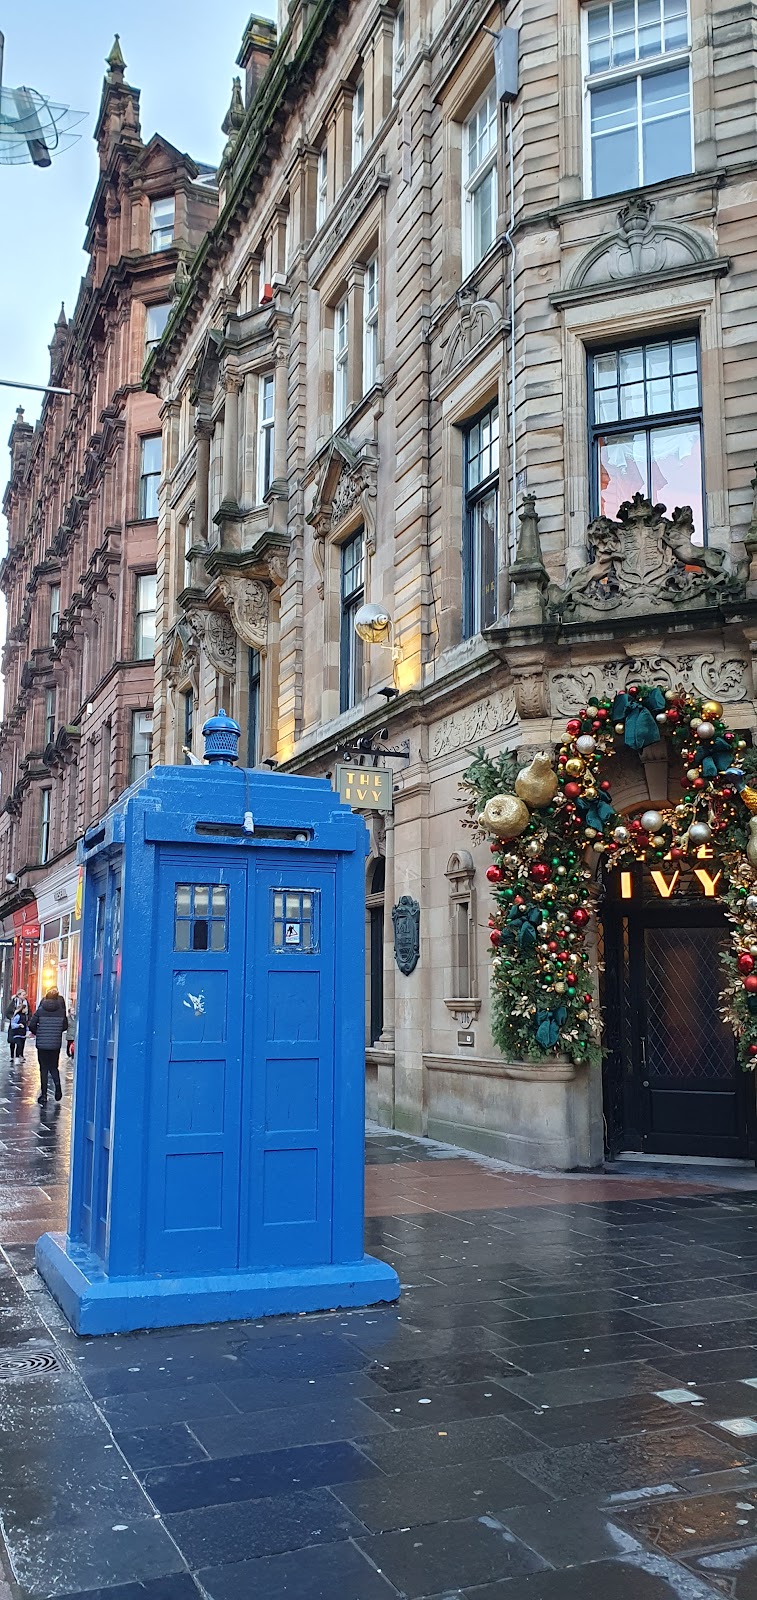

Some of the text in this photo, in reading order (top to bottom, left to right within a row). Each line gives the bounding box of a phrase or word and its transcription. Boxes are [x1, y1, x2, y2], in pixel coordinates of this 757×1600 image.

[346, 772, 382, 787] THE
[345, 788, 382, 802] IVY
[620, 868, 722, 899] IVY
